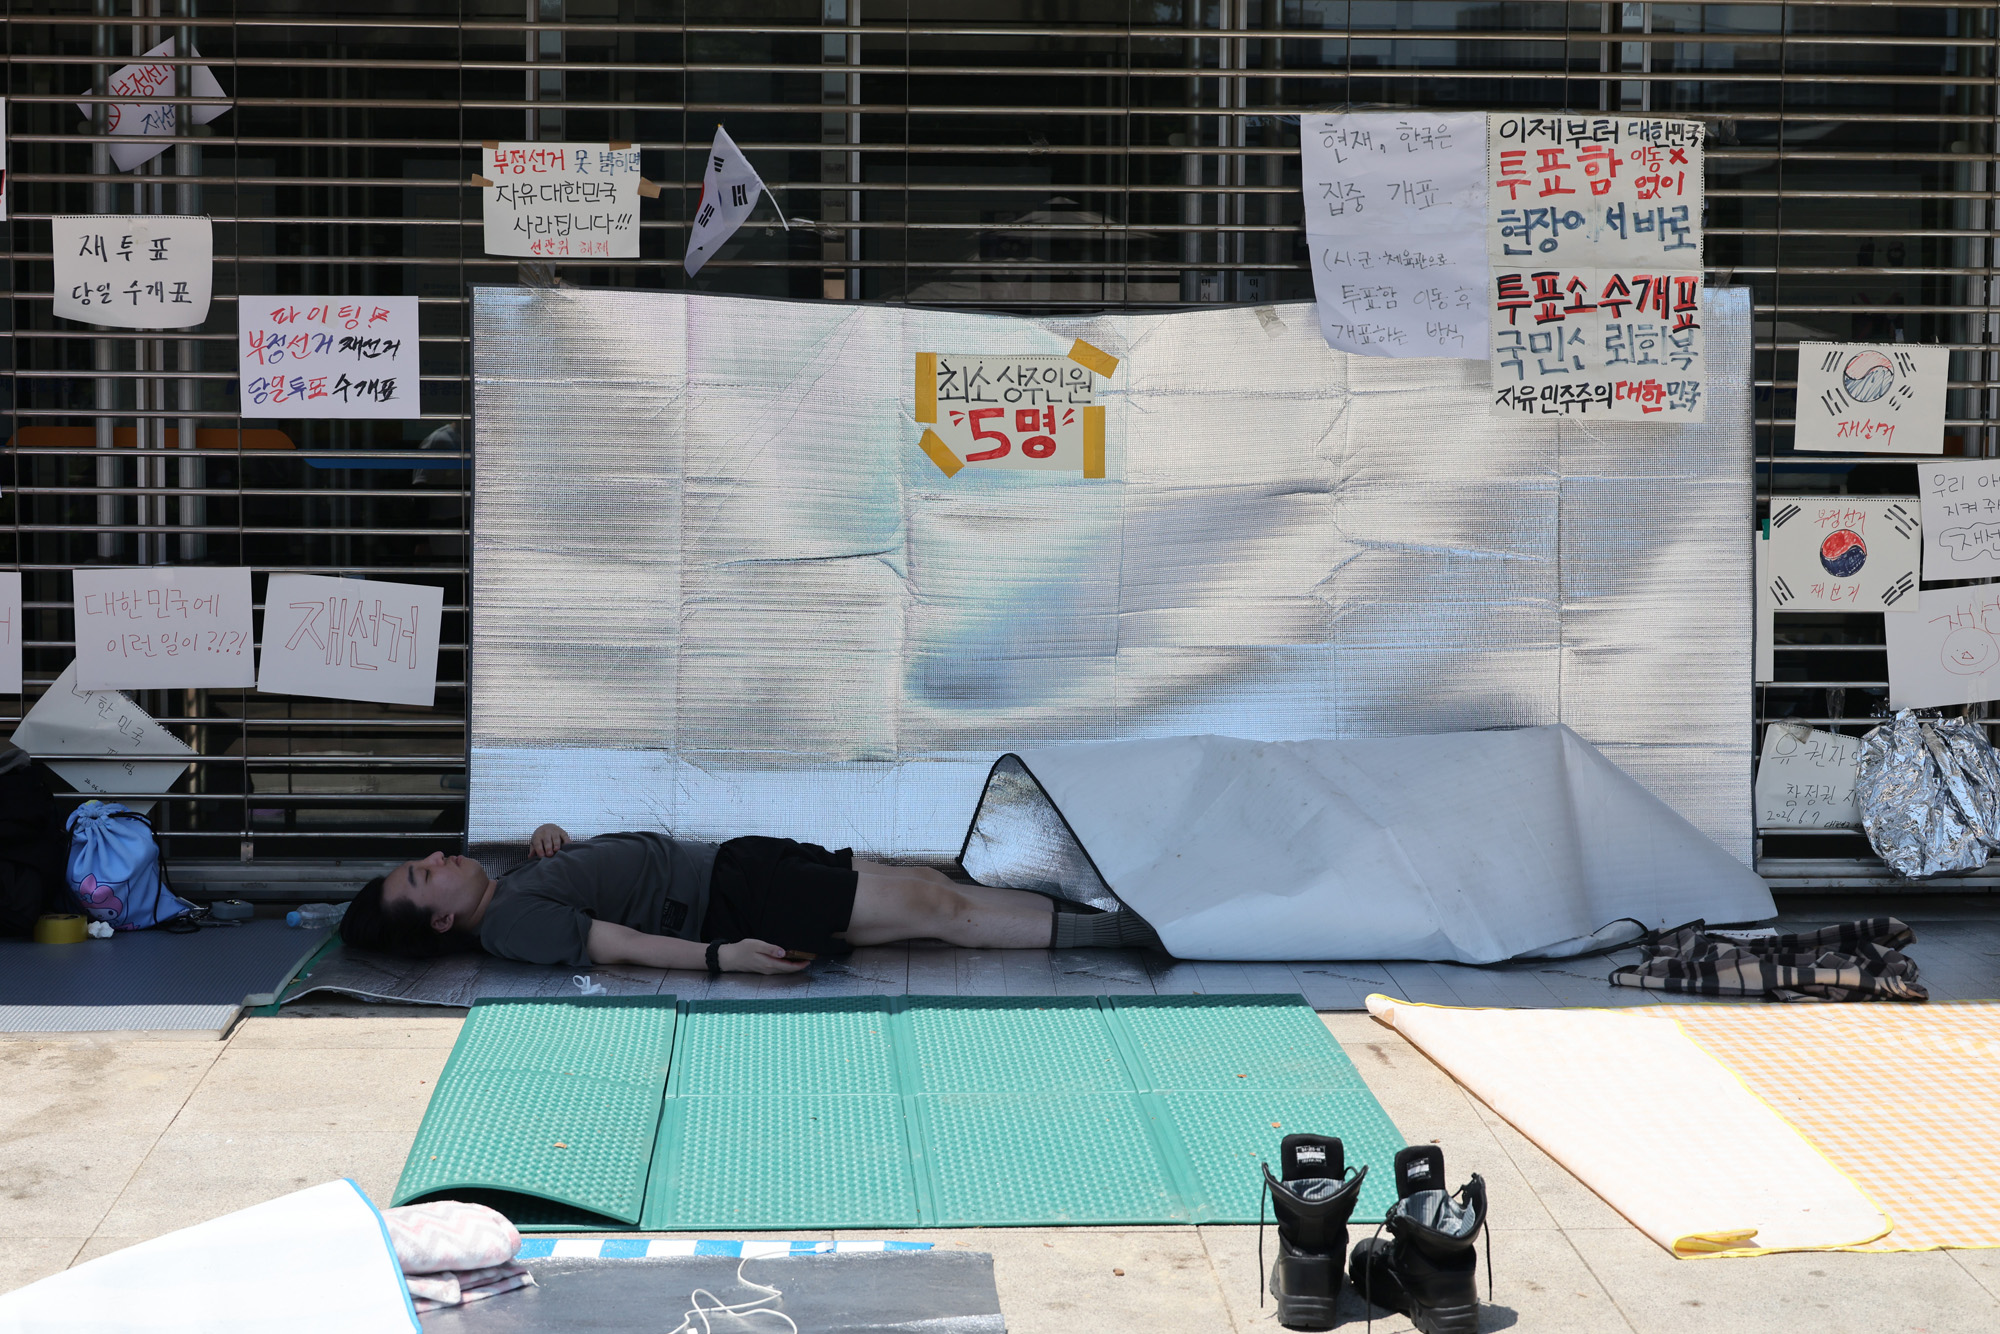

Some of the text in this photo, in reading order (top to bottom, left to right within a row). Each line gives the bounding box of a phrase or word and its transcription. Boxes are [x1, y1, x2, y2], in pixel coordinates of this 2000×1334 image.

[1396, 121, 1453, 152] 한국은
[1500, 117, 1702, 149] 이제부터 대한민국
[493, 149, 565, 175] 부정선거
[574, 149, 592, 174] 못
[1496, 145, 1664, 200] 투표함 이동
[1319, 179, 1453, 217] 집중 개표
[1634, 171, 1685, 200] 없이
[530, 237, 569, 256] 선관위
[72, 280, 193, 306] 당일 수개표
[1341, 285, 1474, 314] 투표함 이동 후
[246, 330, 401, 366] 부정선거 재선거
[1331, 321, 1465, 349] 개표하는 방식
[332, 373, 401, 404] 수개표
[1932, 474, 1965, 498] 우리
[1949, 528, 2000, 551] 재선
[85, 588, 220, 619] 대한민국에
[1928, 594, 2000, 635] 재선
[107, 633, 157, 658] 이런
[285, 596, 419, 671] 재선거
[1786, 783, 1837, 807] 참정권
